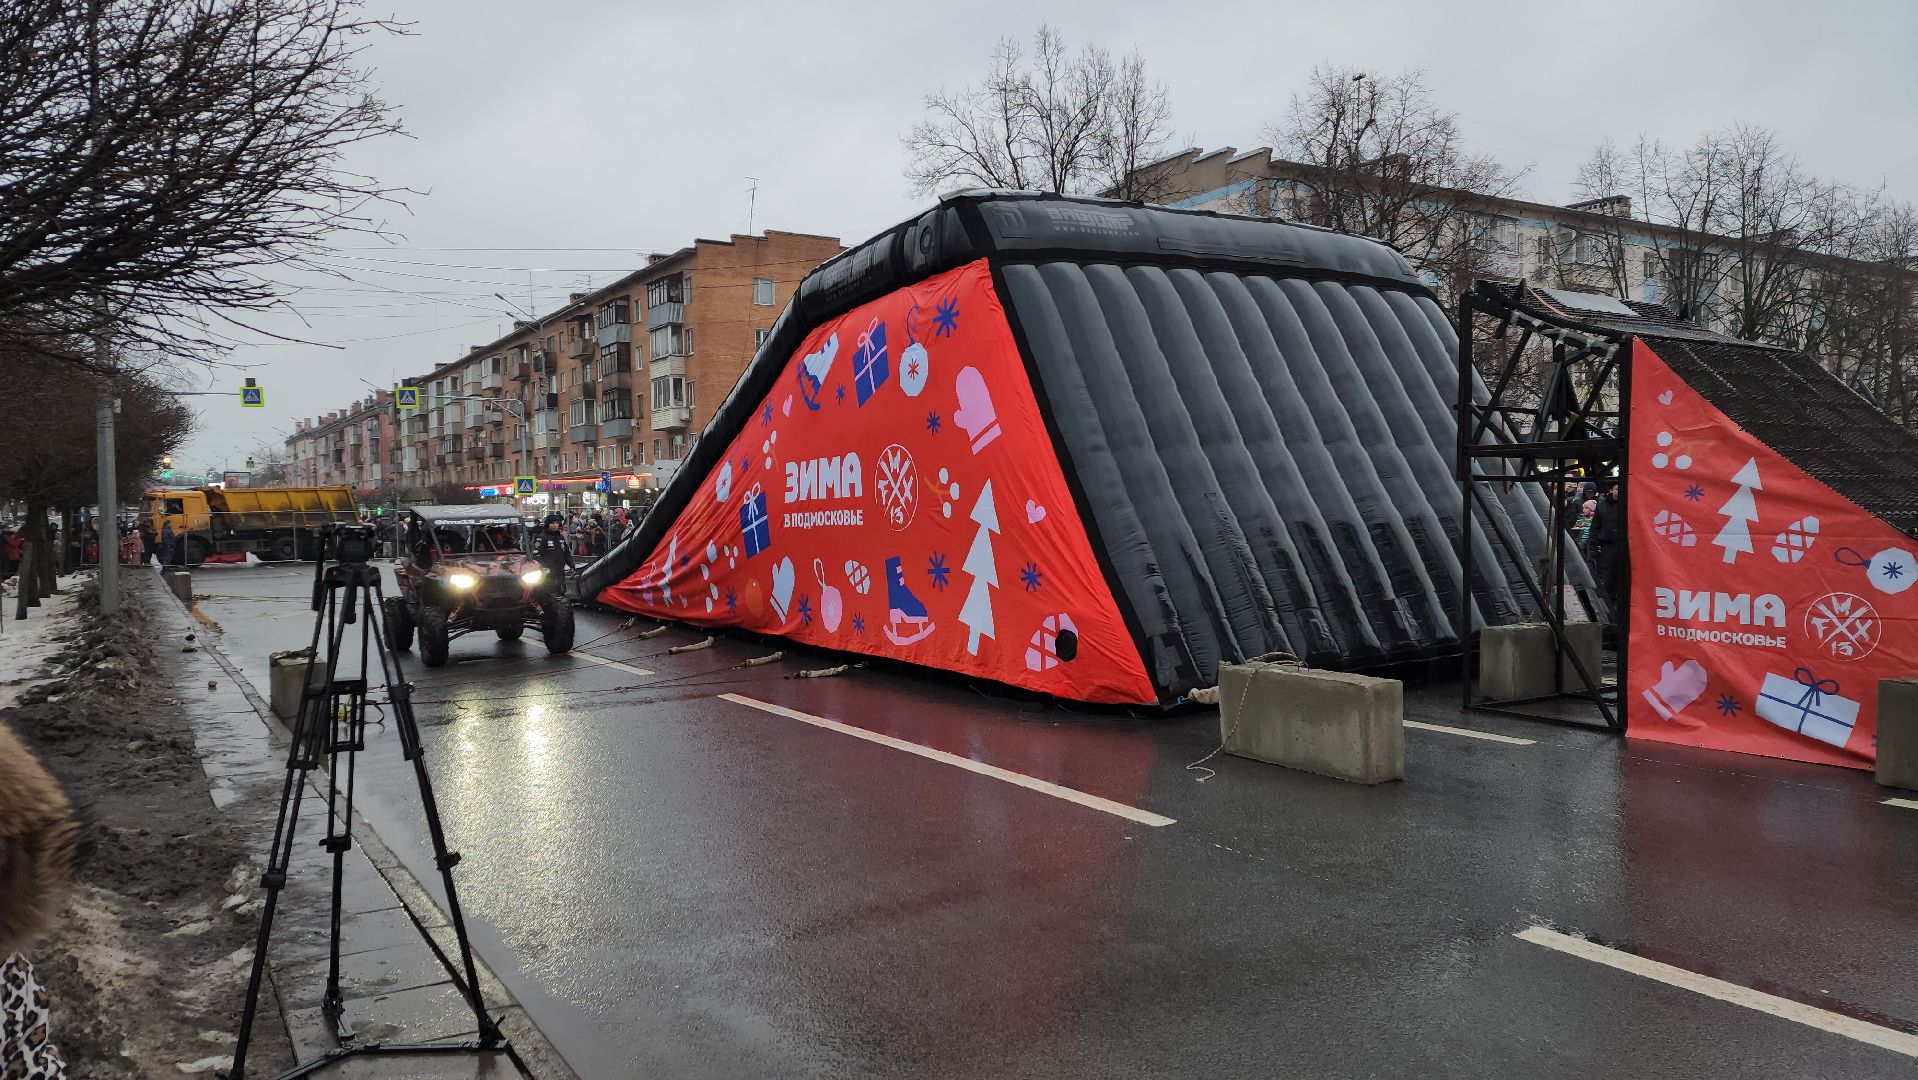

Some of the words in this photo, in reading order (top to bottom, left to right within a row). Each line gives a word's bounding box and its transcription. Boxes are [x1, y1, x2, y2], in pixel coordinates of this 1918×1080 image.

[784, 451, 863, 504] ЗИМА
[784, 514, 791, 528] В
[792, 509, 864, 529] ПОДМОСКОВЬЕ
[1655, 586, 1786, 628] ЗИМА
[1657, 625, 1666, 636] В
[1668, 625, 1786, 649] ПОДМОСКОВЬЕ
